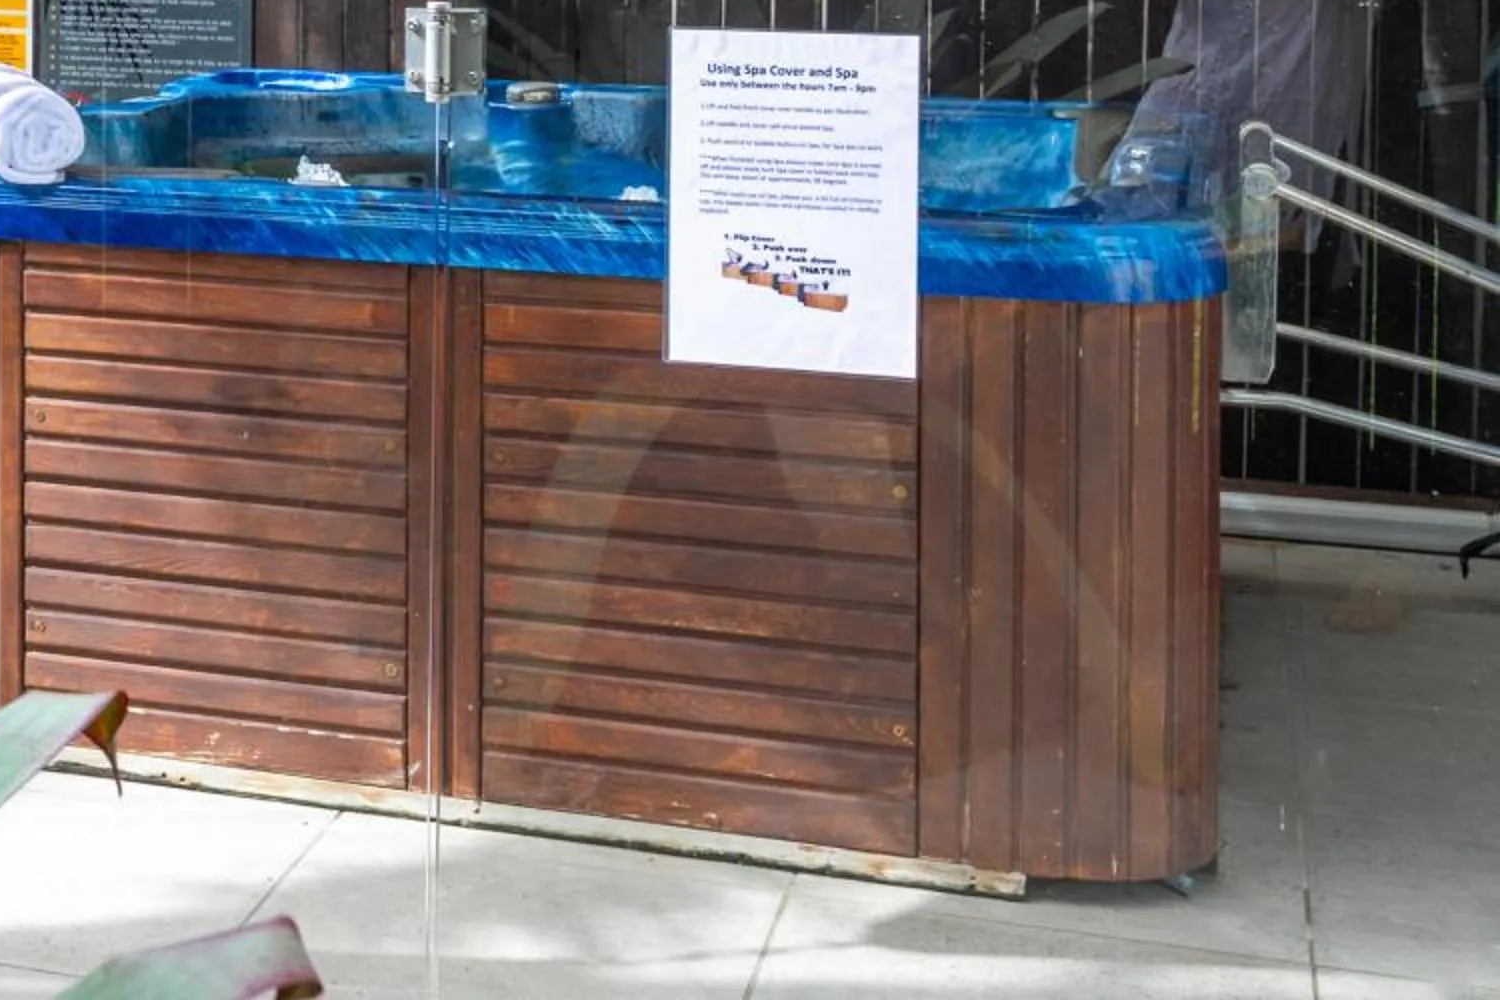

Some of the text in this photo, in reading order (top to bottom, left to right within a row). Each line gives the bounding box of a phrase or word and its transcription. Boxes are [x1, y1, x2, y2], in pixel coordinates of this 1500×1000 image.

[707, 63, 859, 80] Using Spa Cover and Spa
[719, 80, 738, 90] only
[740, 80, 780, 90] between
[782, 81, 797, 90] the
[800, 82, 825, 91] hours
